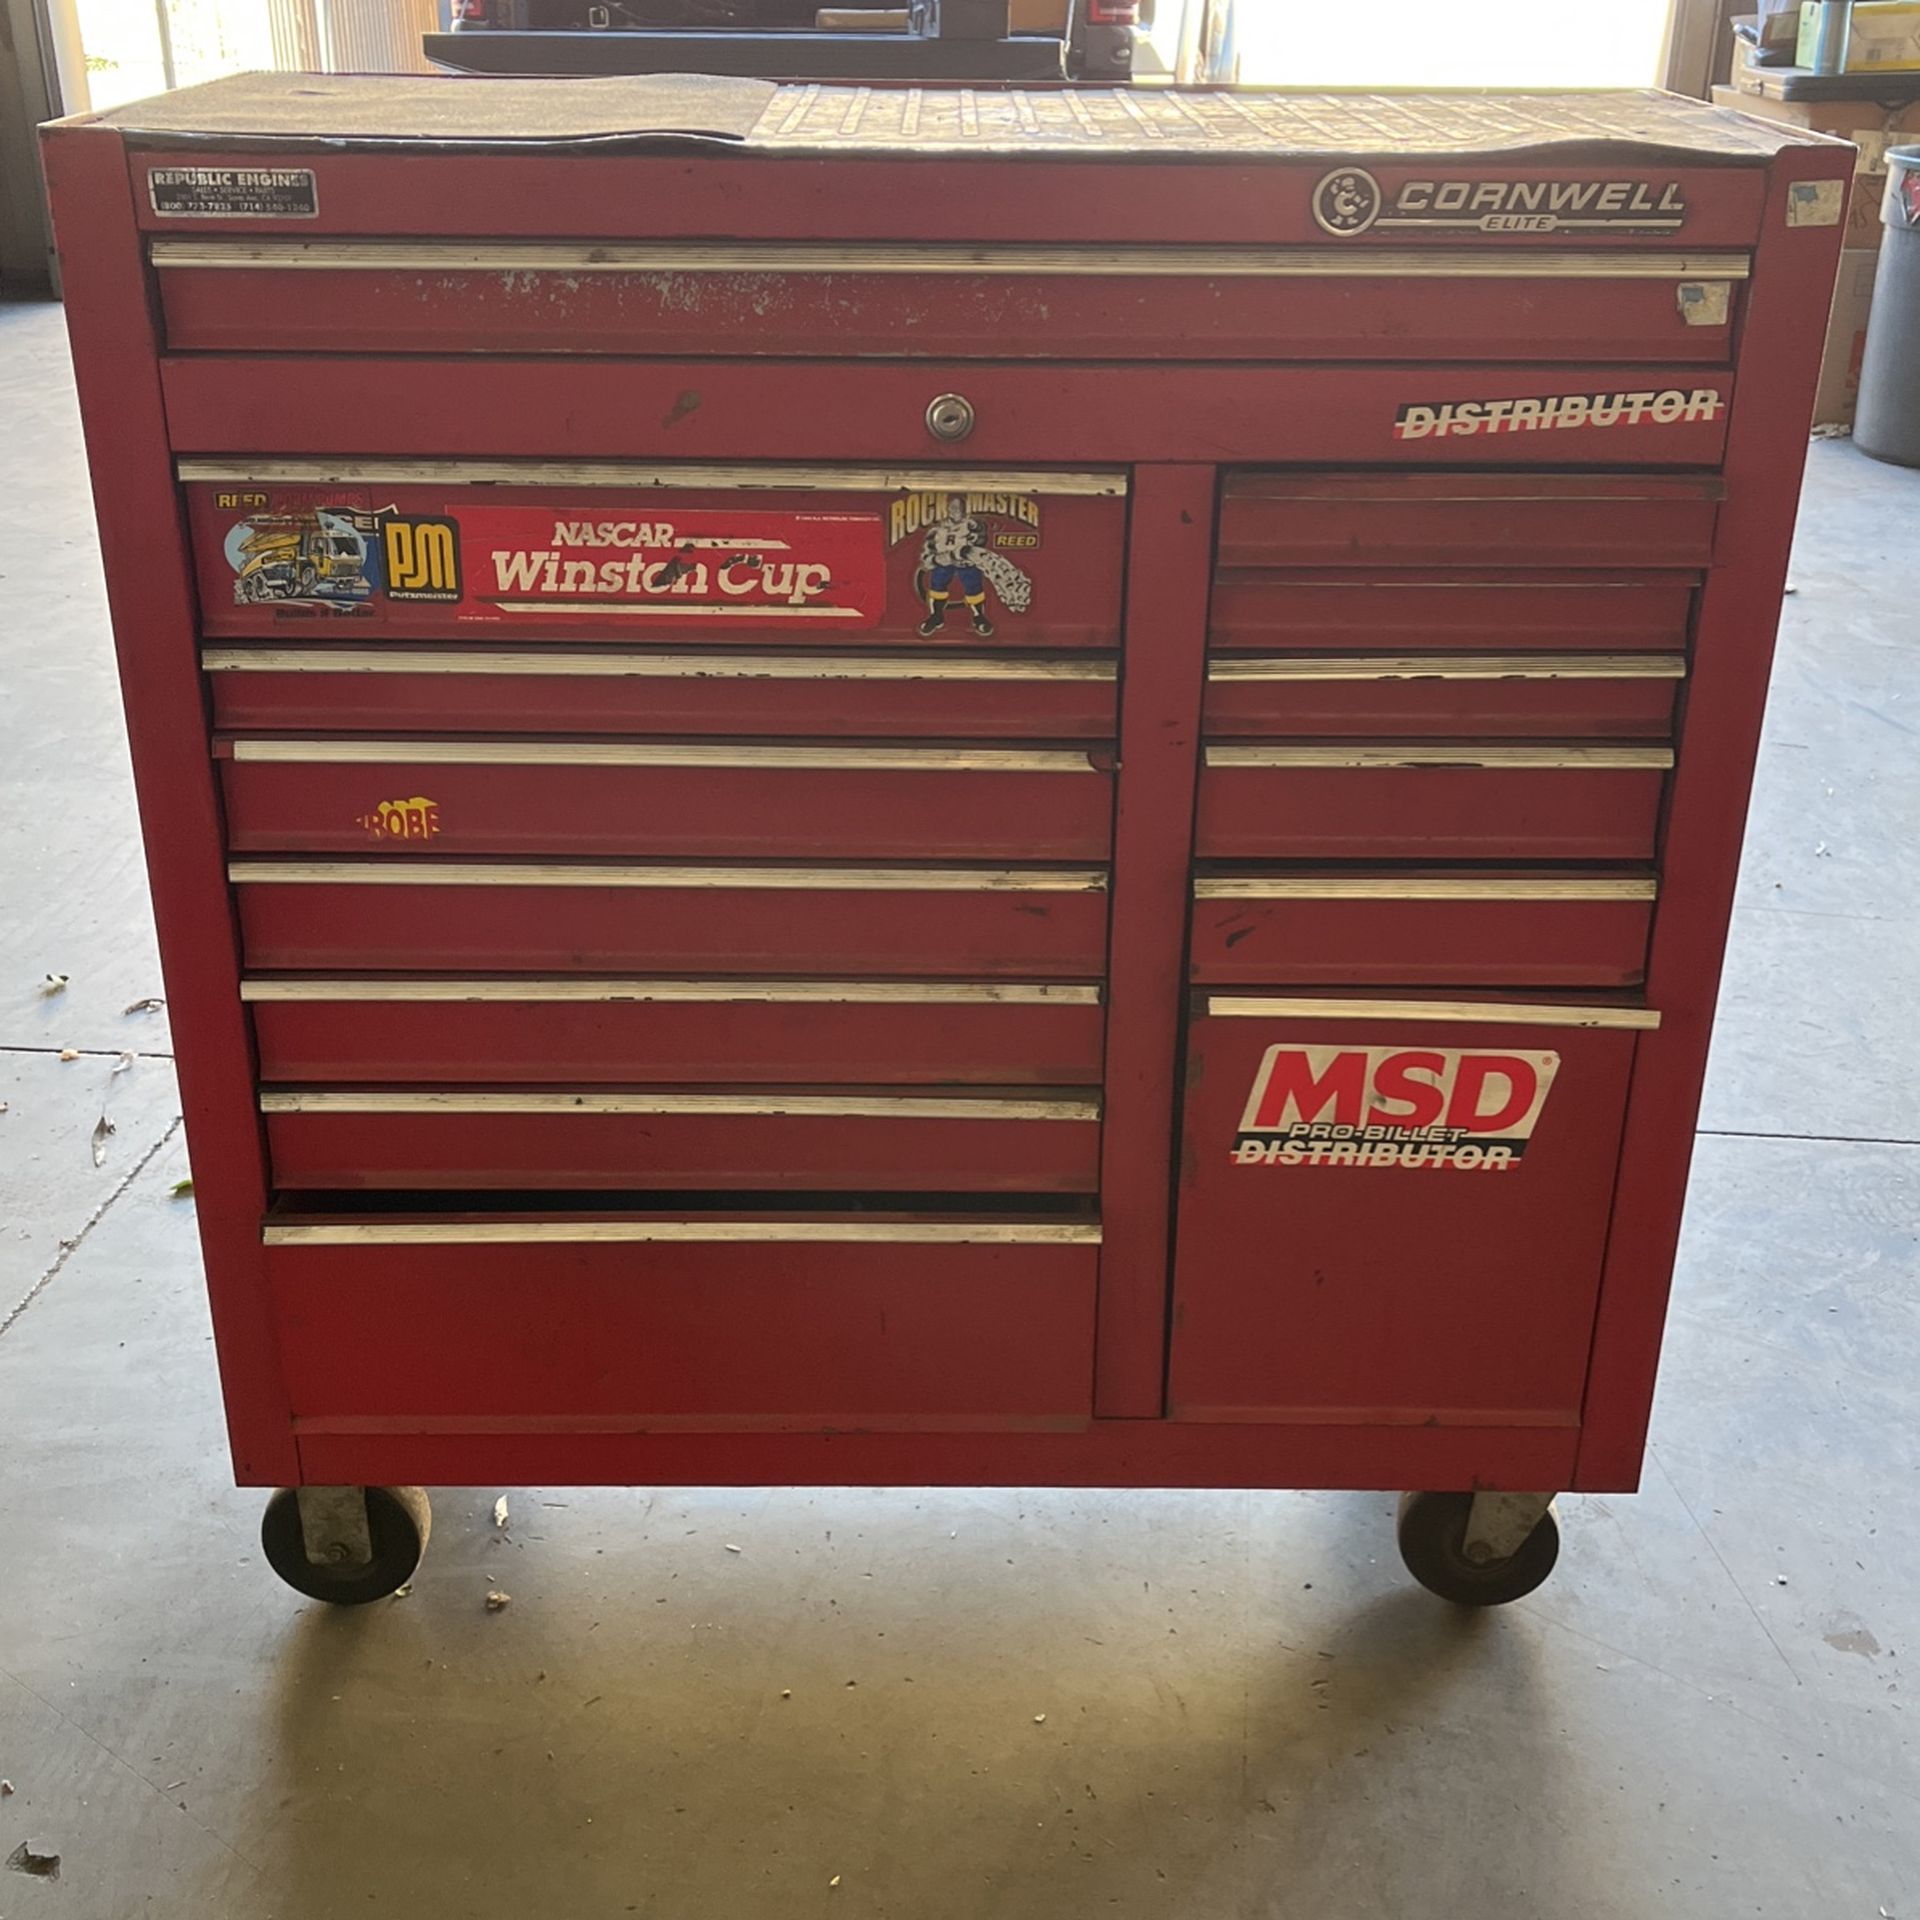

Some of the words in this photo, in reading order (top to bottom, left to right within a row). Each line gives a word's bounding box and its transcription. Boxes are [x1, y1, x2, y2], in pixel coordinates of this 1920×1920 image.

[154, 172, 232, 186] REPUBLIC
[237, 173, 309, 187] ENGINES
[1396, 181, 1685, 211] CORNWELL
[1486, 216, 1552, 230] ELITE
[1400, 388, 1720, 439] DISTRIBUTOR
[890, 492, 949, 546] ROCK
[965, 492, 1039, 528] MASTER
[550, 521, 675, 548] NASCAR
[996, 535, 1036, 546] REED
[491, 550, 709, 594] Winston
[717, 553, 831, 604] Cup
[1253, 1050, 1538, 1133] MSD
[1288, 1122, 1468, 1143] PRO-BILLET
[1234, 1139, 1513, 1171] DISTRIBUTOR
